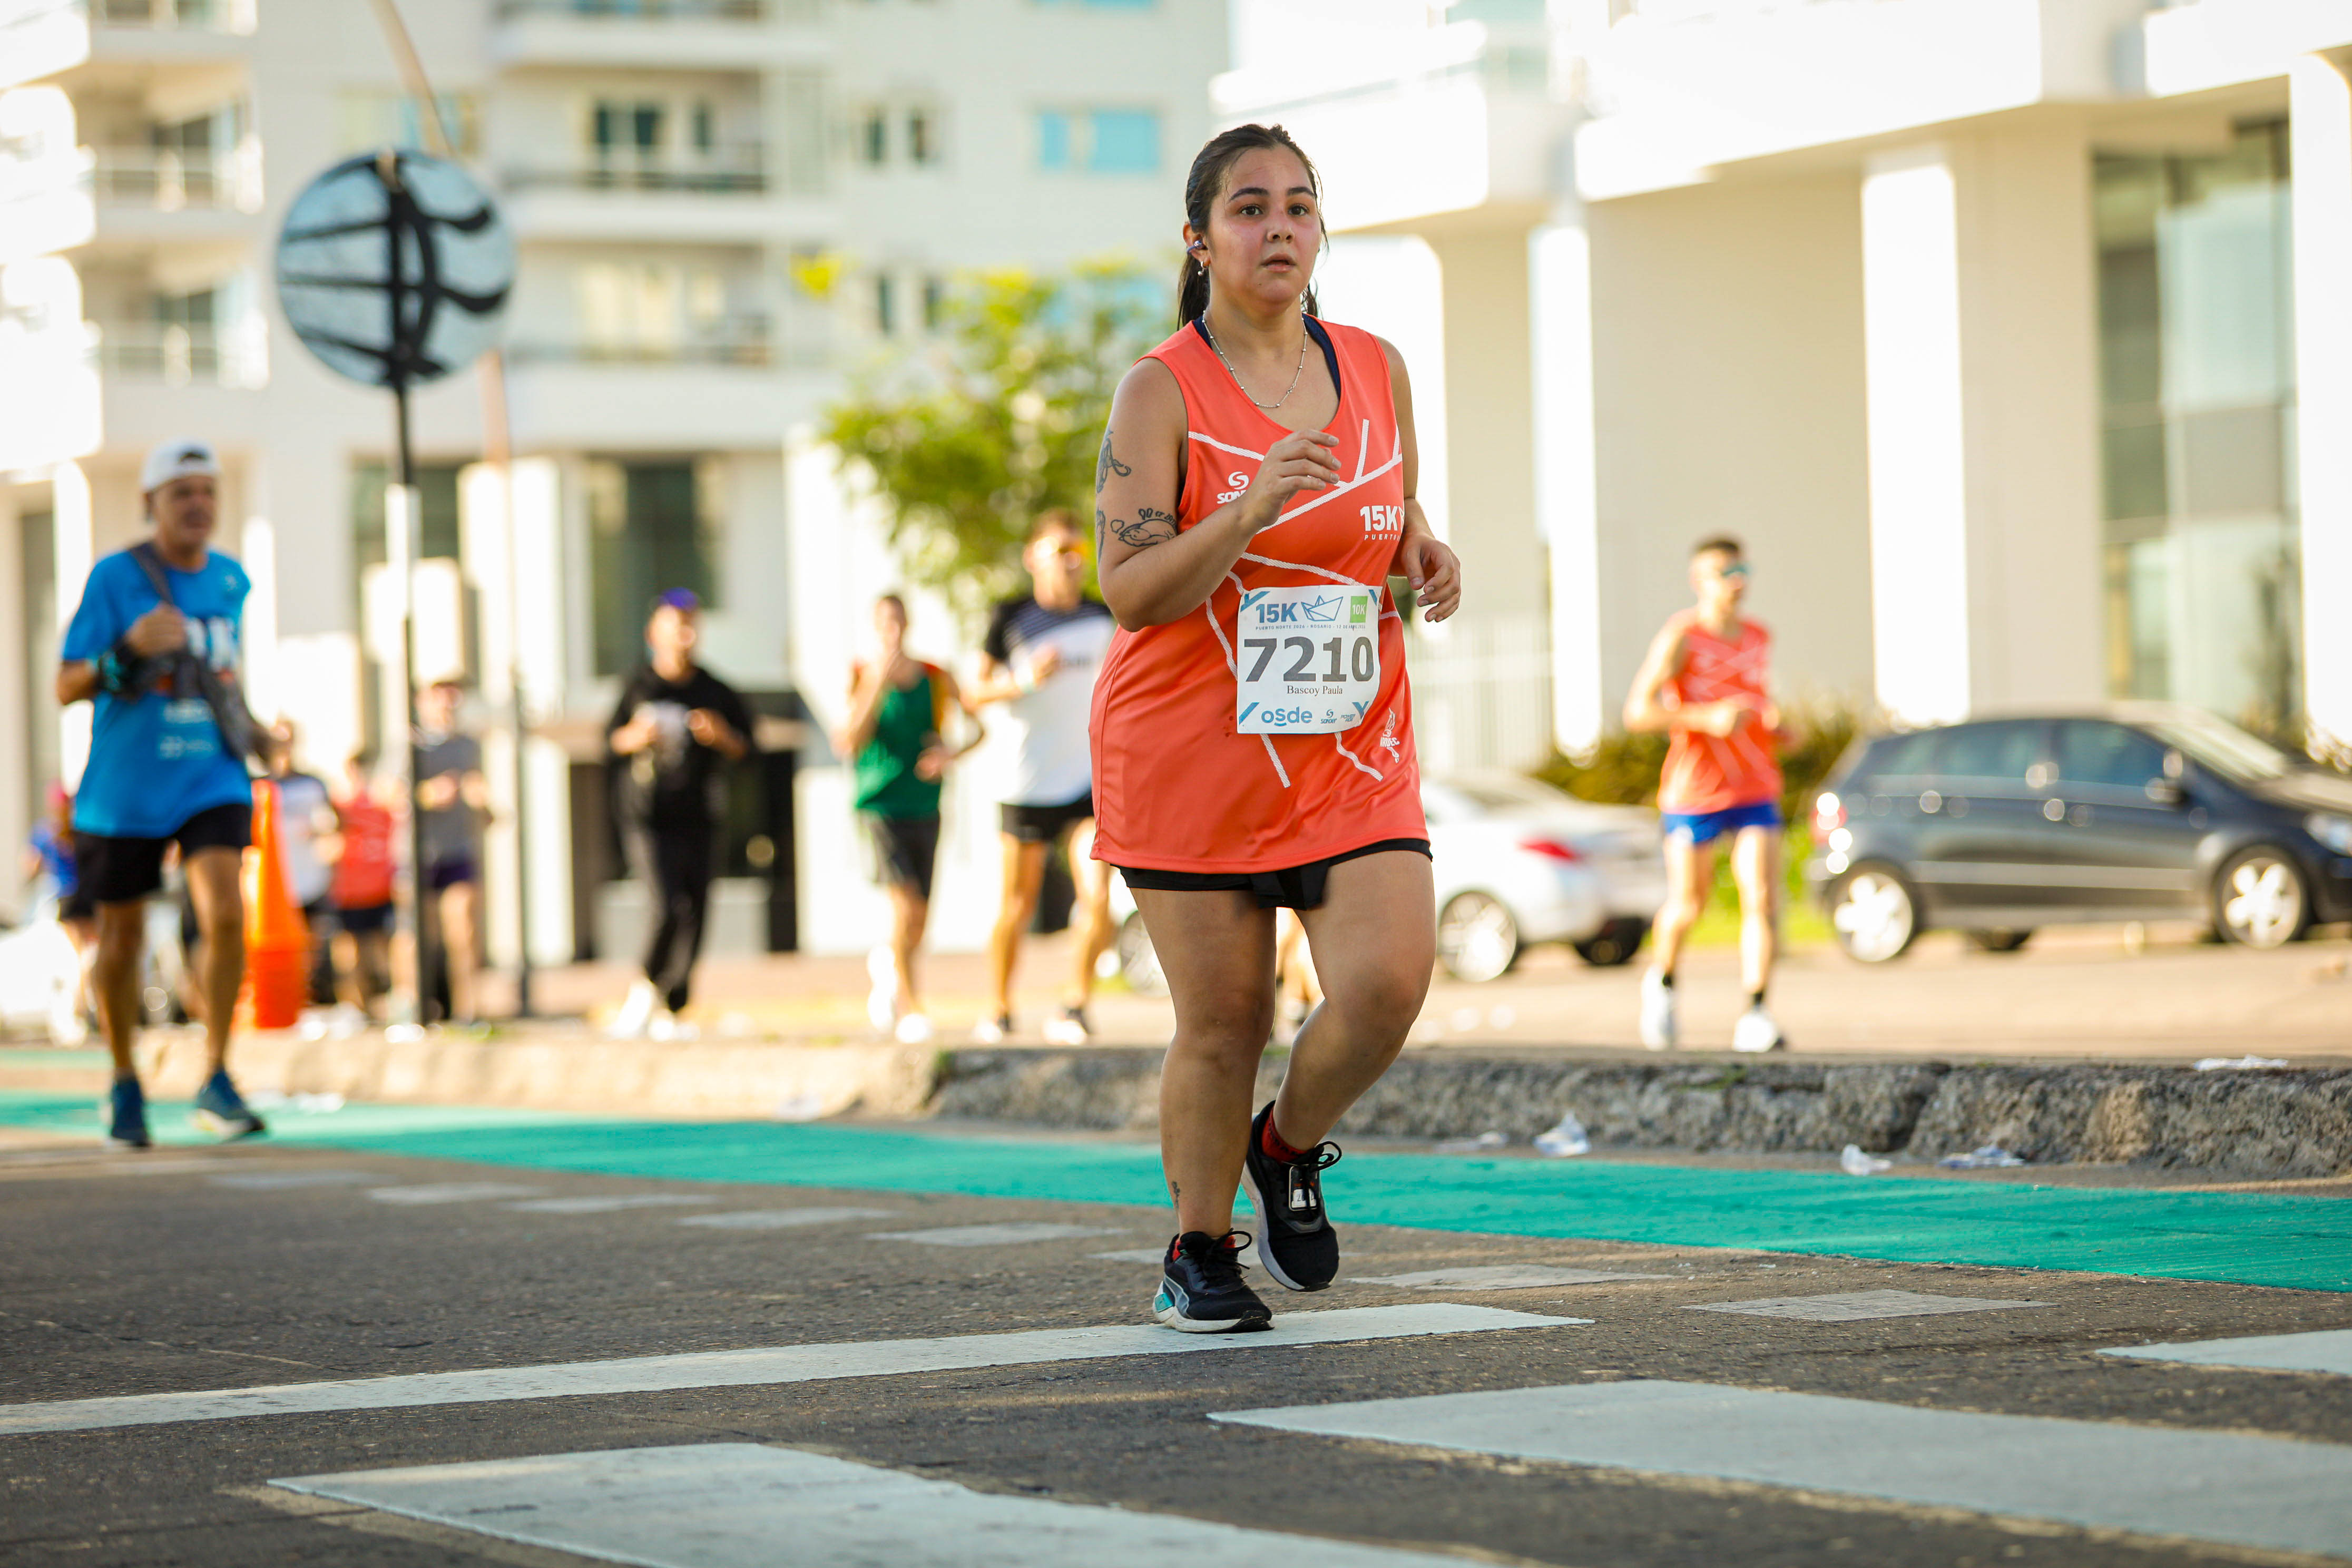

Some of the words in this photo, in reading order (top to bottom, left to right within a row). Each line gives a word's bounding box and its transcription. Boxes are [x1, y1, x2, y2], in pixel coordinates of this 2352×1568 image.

[1217, 489, 1247, 504] SON
[1360, 505, 1398, 531] 15K
[1256, 602, 1298, 623] 15K
[1353, 604, 1366, 615] 10K
[1244, 636, 1374, 682] 7210
[1287, 685, 1320, 696] Bascoy
[1322, 686, 1343, 694] Paula
[1261, 706, 1312, 726] osde
